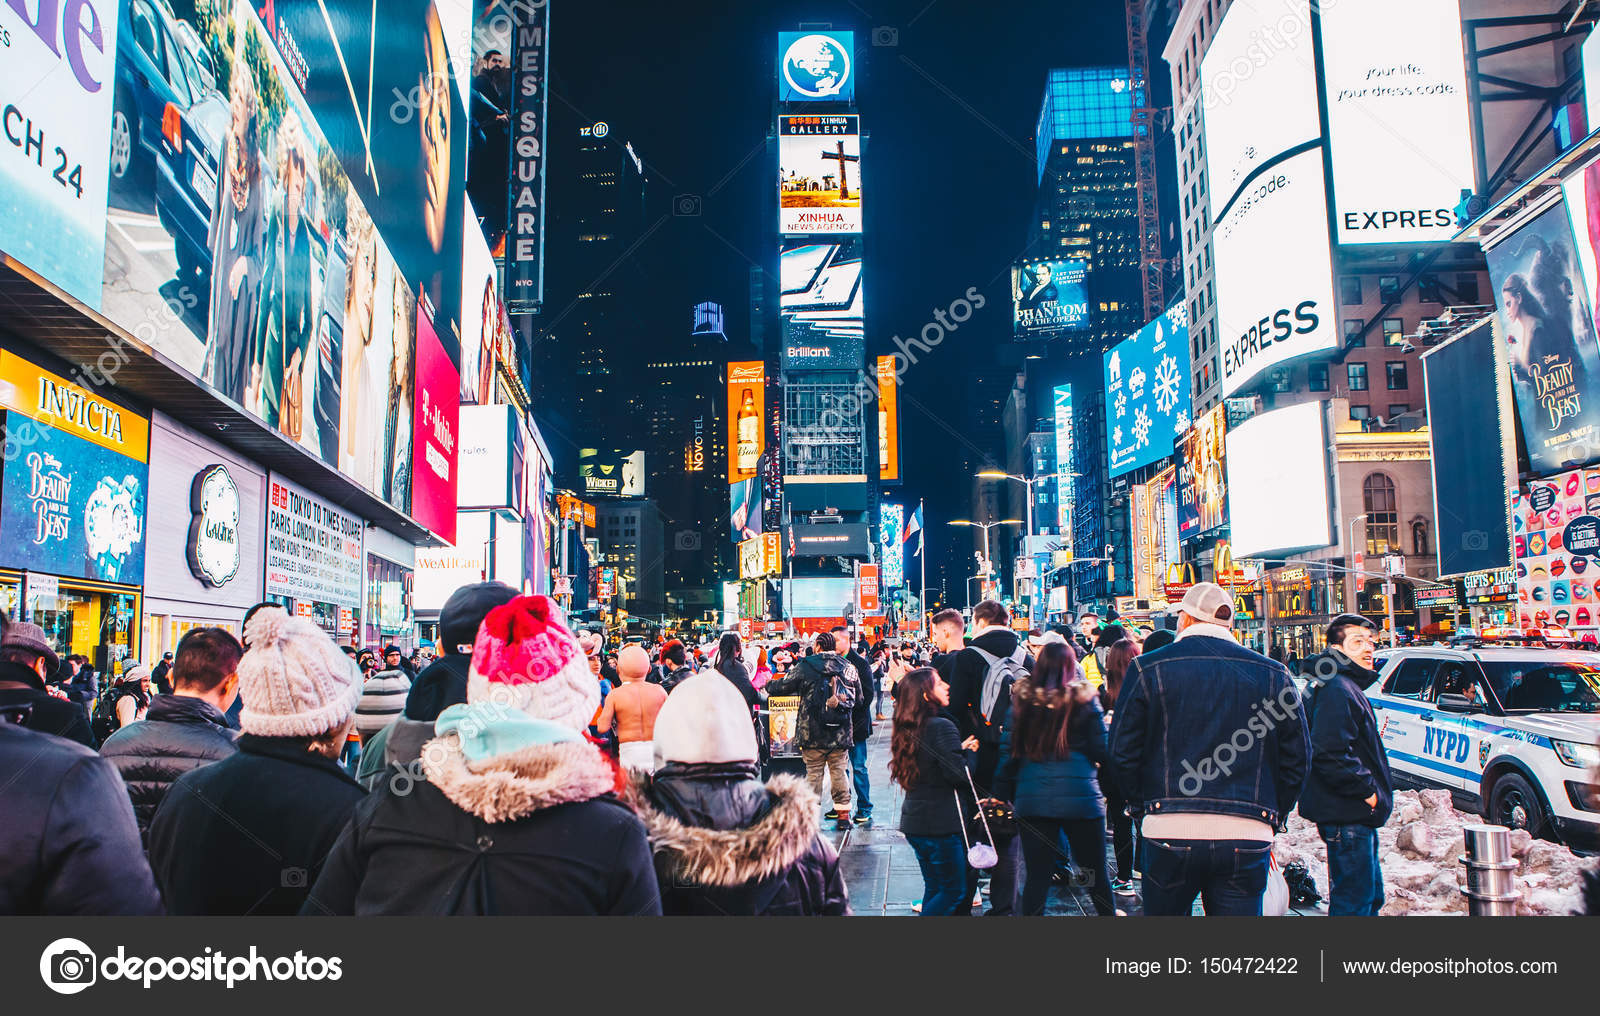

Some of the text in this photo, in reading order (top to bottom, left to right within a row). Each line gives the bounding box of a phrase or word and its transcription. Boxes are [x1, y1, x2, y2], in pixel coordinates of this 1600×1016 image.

[1338, 88, 1368, 102] your
[1371, 84, 1413, 97] dress
[790, 126, 847, 134] GALLERY
[821, 117, 847, 125] XINHUA
[53, 146, 83, 199] 24
[516, 112, 540, 261] SQUARE
[1254, 174, 1291, 203] code.
[787, 223, 855, 231] NEWS AGENCY
[798, 213, 844, 223] XINHUA
[1016, 303, 1088, 322] PHANTOM
[1041, 300, 1059, 308] THE
[1021, 313, 1082, 327] OF THE OPERA
[787, 346, 830, 358] Brilliant
[1224, 300, 1320, 379] EXPRESS
[1528, 357, 1574, 400] BEAUTY
[38, 376, 125, 445] INVICTA
[1542, 393, 1582, 431] BEAST
[693, 415, 704, 471] NOVOTEL
[26, 451, 72, 504] BEAUTY
[1182, 485, 1196, 508] FIST
[32, 498, 72, 544] BEAST
[270, 510, 291, 535] PARIS
[292, 518, 316, 543] LONDON
[317, 528, 330, 548] NEW
[289, 491, 311, 520] TOKYO
[313, 502, 322, 524] TO
[323, 506, 340, 532] TIMES
[340, 516, 361, 541] SQUARE
[270, 534, 286, 553] HONG
[1138, 494, 1150, 574] PALACE
[1464, 574, 1488, 590] GIFTS
[1423, 725, 1471, 764] NYPD
[1510, 730, 1539, 745] POLICE
